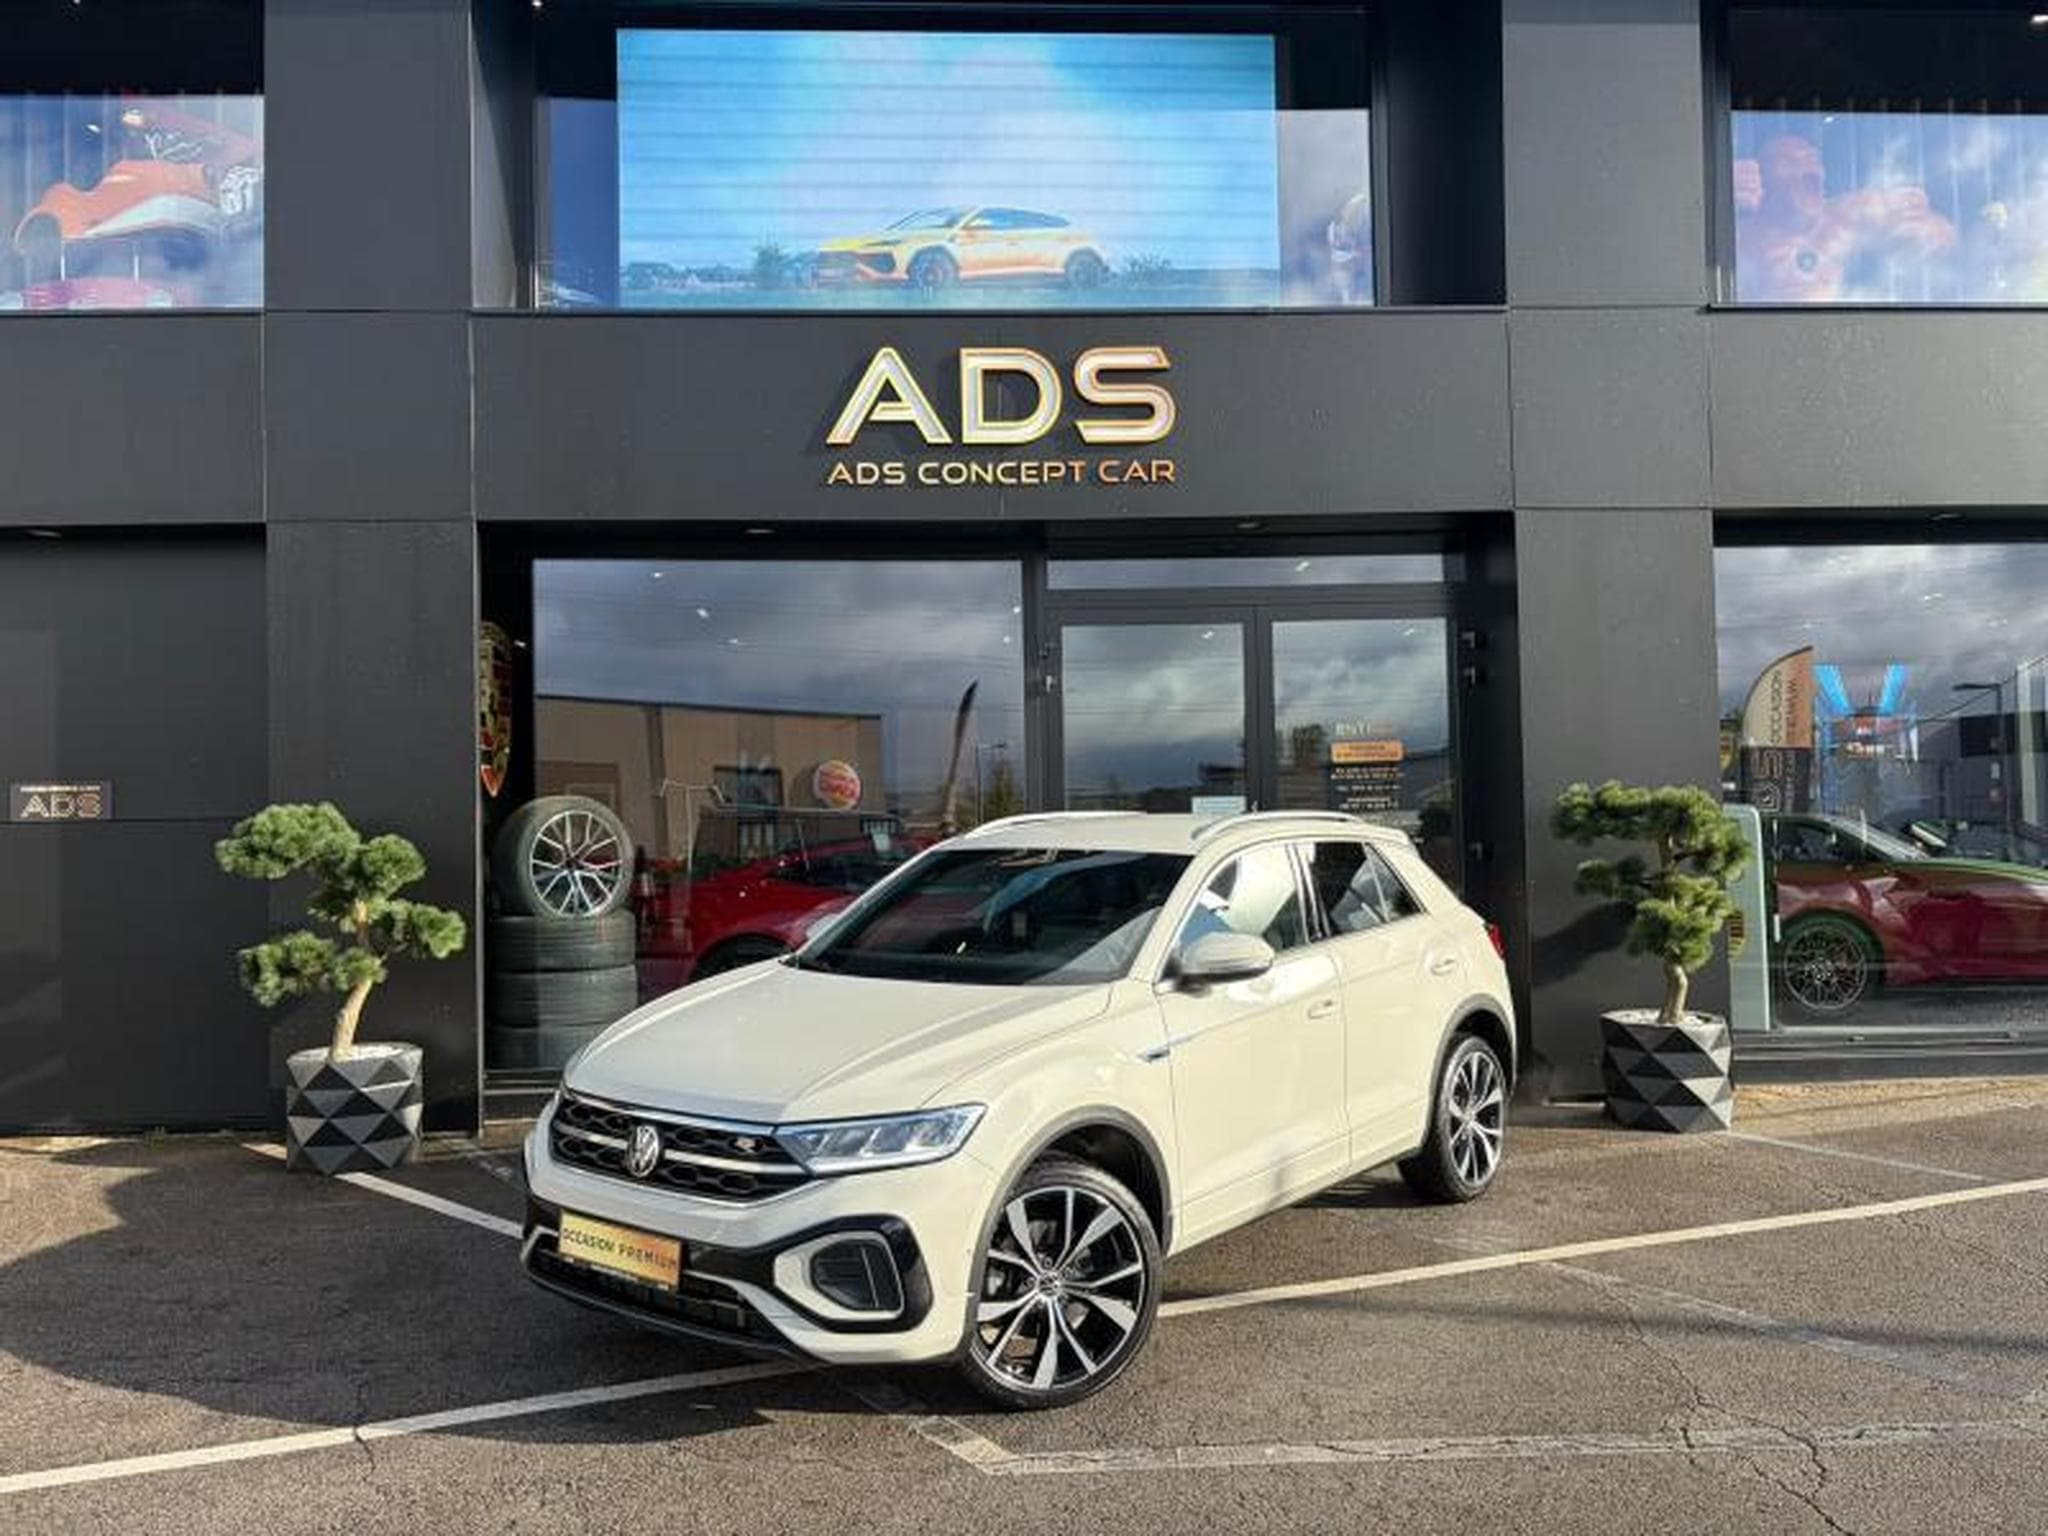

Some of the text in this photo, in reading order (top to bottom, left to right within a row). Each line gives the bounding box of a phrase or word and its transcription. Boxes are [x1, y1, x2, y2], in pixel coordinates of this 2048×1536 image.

[826, 346, 1176, 444] ADS
[827, 459, 1177, 485] ADS CONCEPT CAR
[20, 793, 102, 818] ADS
[562, 1228, 677, 1270] OCCASION PREMIUM
